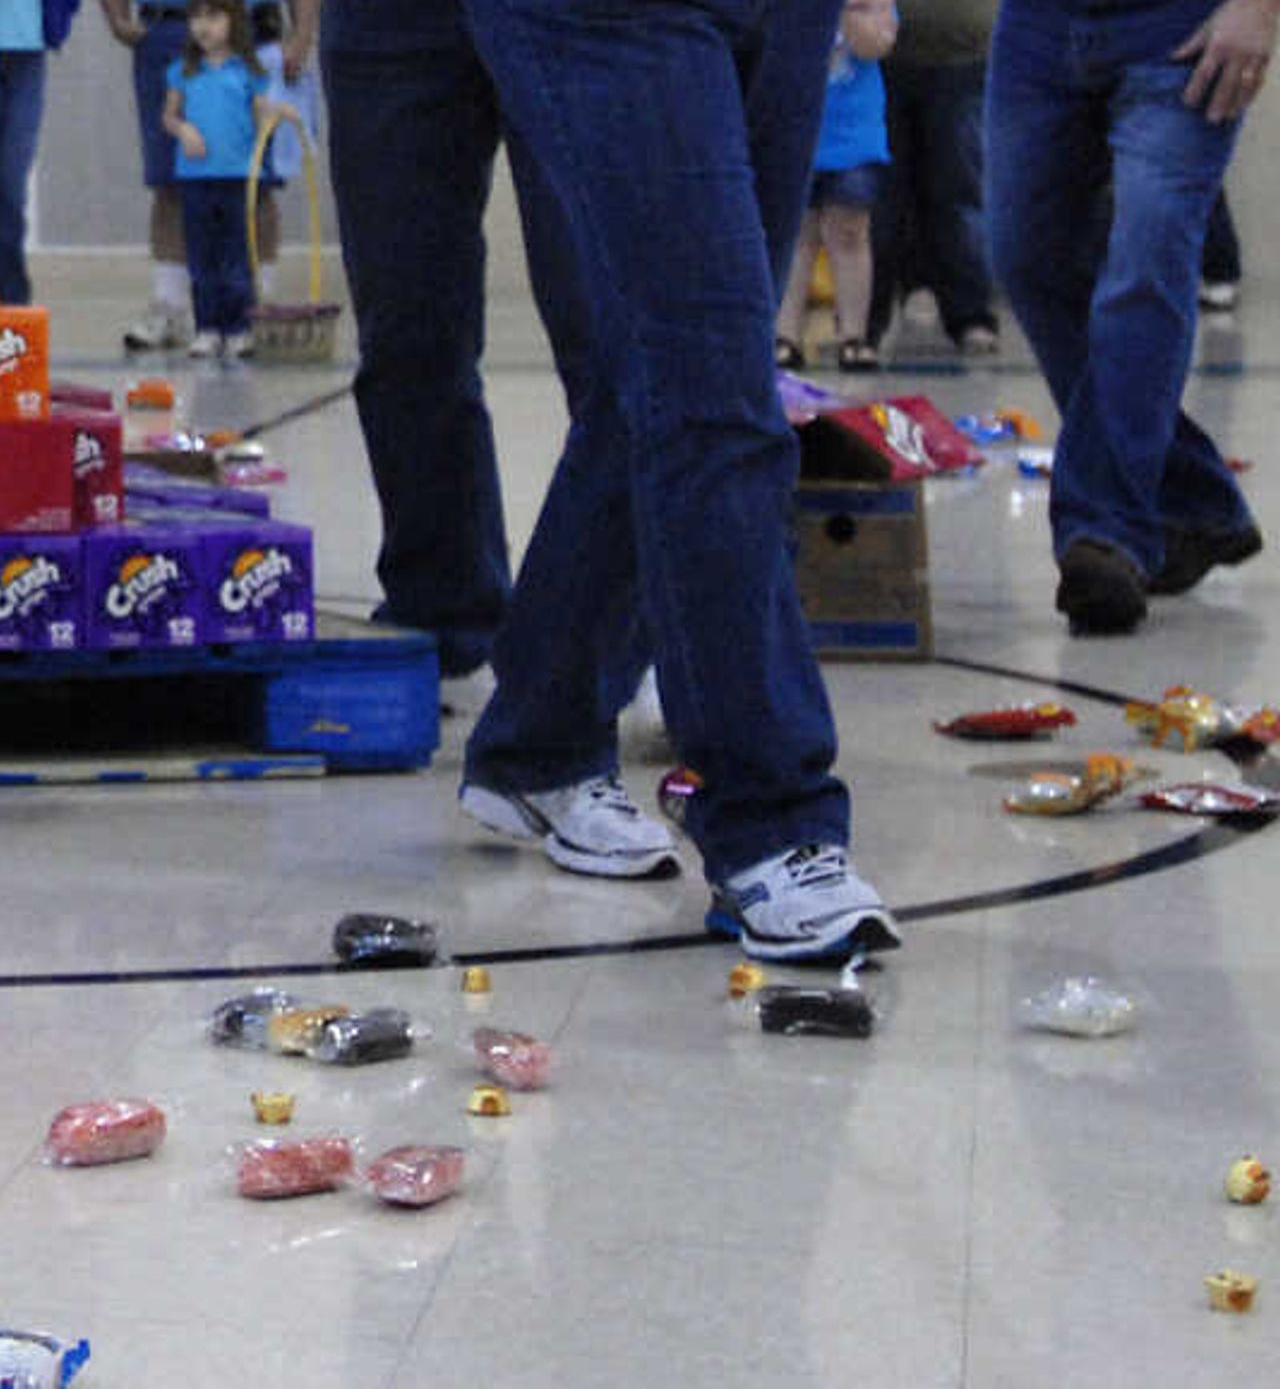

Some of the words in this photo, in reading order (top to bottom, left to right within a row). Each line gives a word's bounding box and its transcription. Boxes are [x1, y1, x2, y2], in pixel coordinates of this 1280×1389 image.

[105, 553, 179, 618] Crush
[219, 547, 291, 612] Crush
[167, 618, 195, 639] 12
